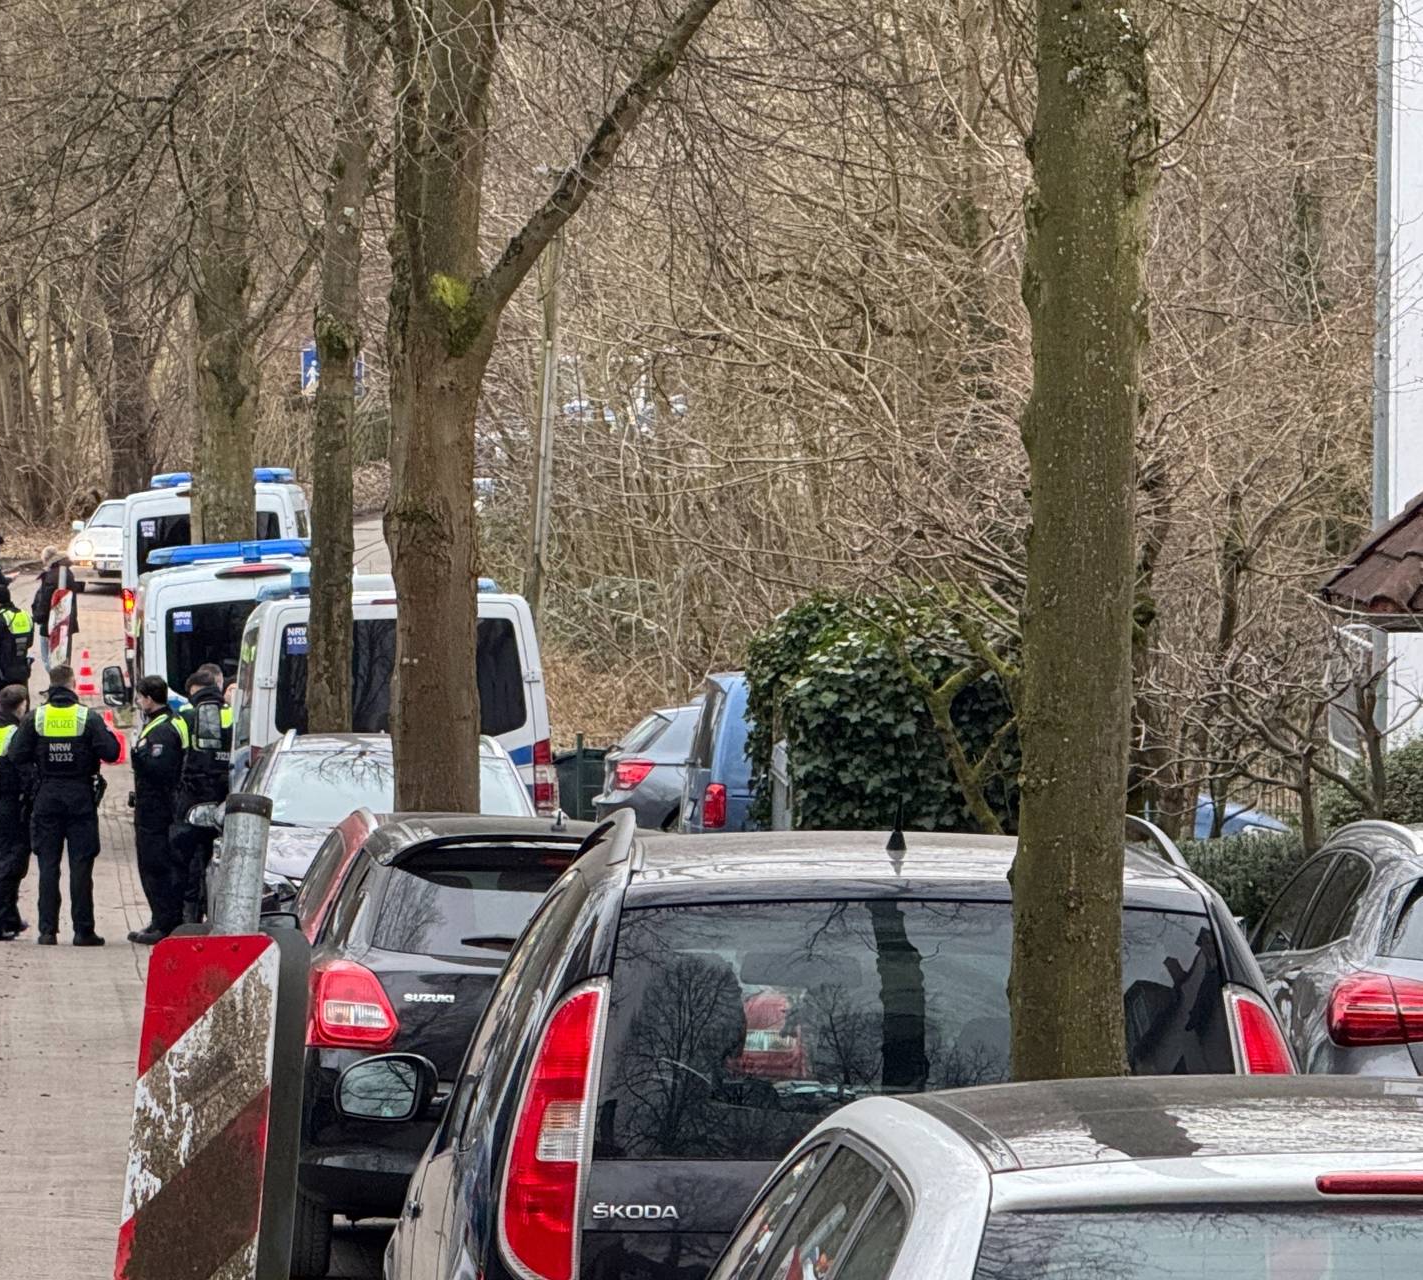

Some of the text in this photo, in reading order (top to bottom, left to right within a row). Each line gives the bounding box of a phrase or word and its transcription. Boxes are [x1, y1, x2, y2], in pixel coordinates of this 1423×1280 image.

[47, 719, 75, 729] POLIZEI
[49, 742, 72, 752] NRW
[48, 752, 74, 762] 31232
[403, 993, 456, 1004] SUZUKI
[592, 1201, 679, 1219] ŠKODA
